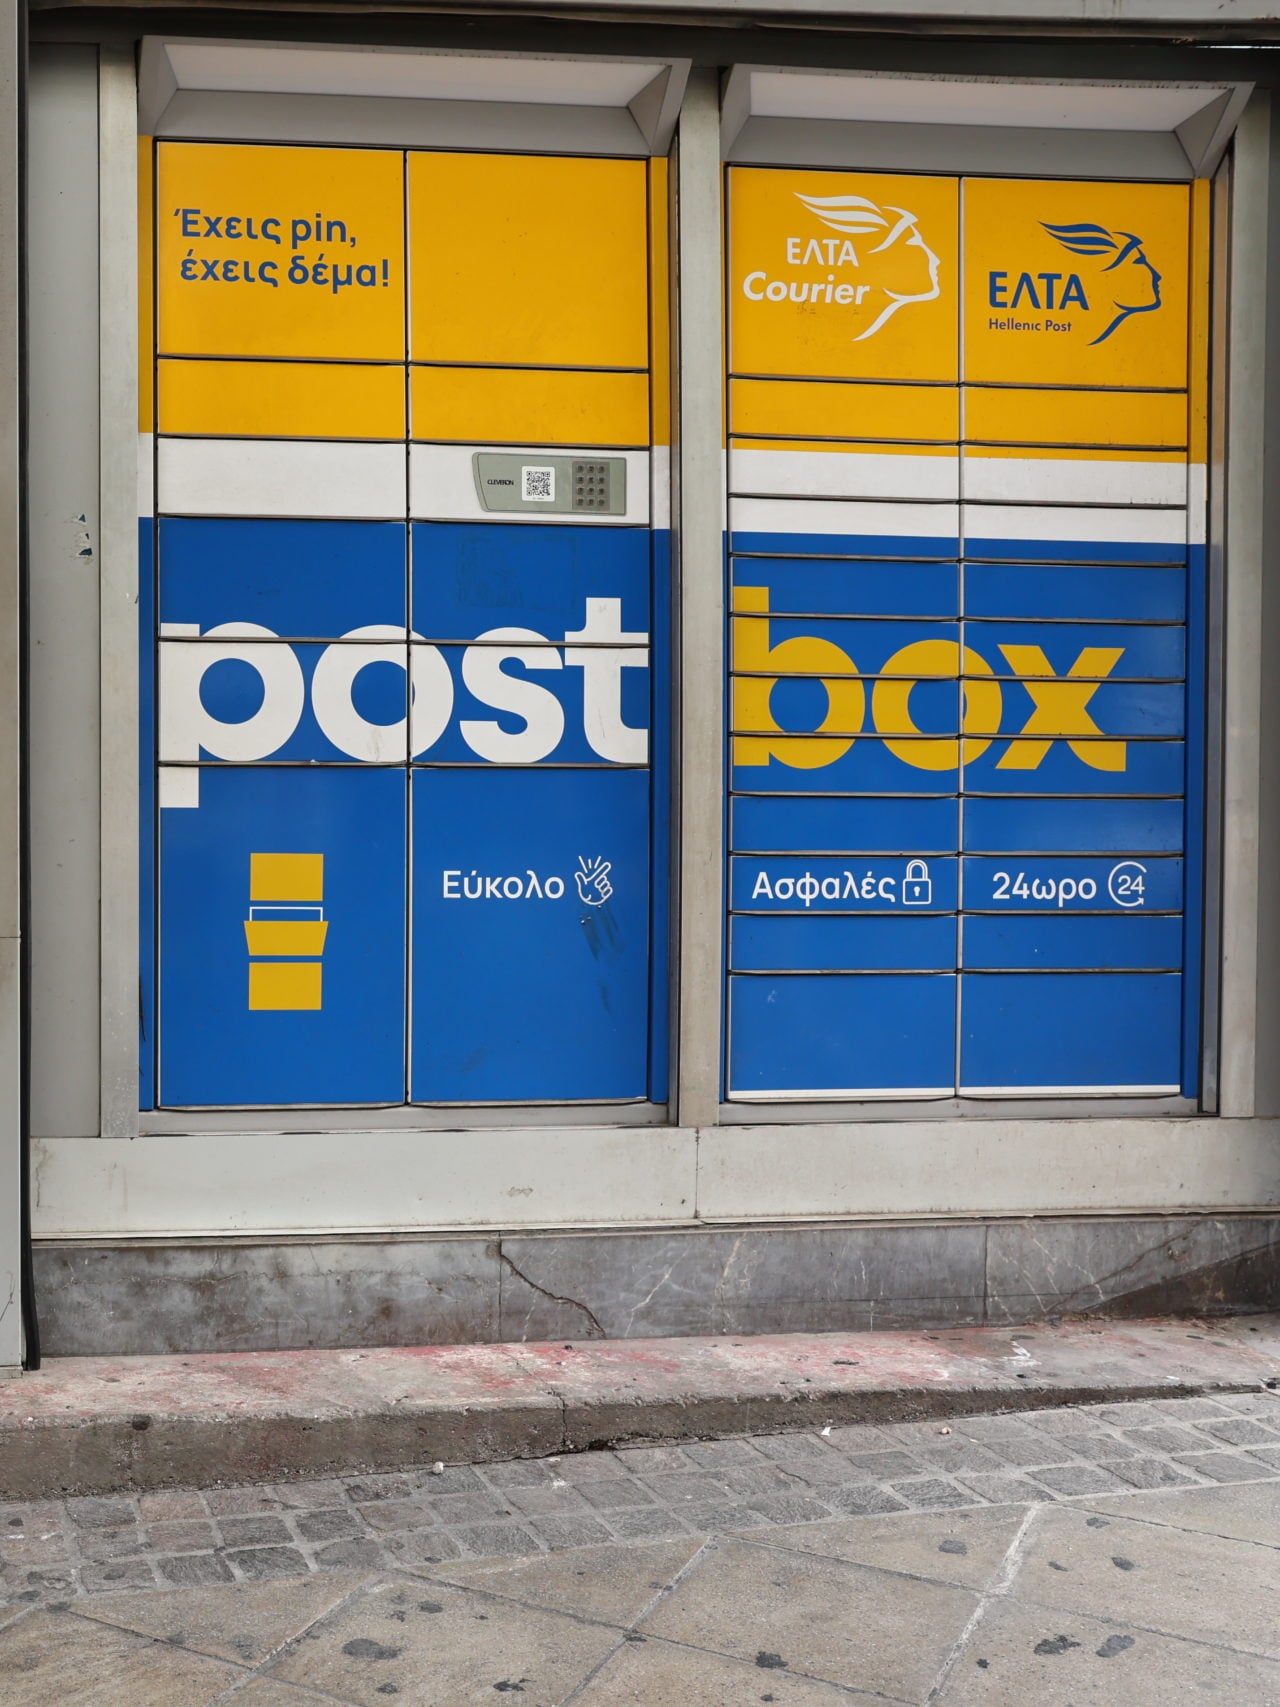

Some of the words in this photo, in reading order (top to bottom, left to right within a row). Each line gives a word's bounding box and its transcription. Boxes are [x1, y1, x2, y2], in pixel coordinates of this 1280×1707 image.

[174, 208, 281, 245] Έχεις
[291, 213, 356, 250] pin,
[787, 236, 859, 267] ΕΛΤΑ
[180, 250, 279, 288] έχεις
[287, 253, 389, 295] δέμα!
[742, 270, 870, 305] Courier
[989, 271, 1089, 311] ΕΛΤΑ
[989, 318, 1040, 331] Hellenic
[1045, 319, 1071, 332] Post
[733, 586, 1127, 772] box
[159, 598, 649, 809] post
[443, 869, 565, 899] Εύκολο
[751, 870, 896, 906] Ασφαλές
[992, 871, 1097, 908] 24ωρο
[1117, 874, 1146, 895] 24
